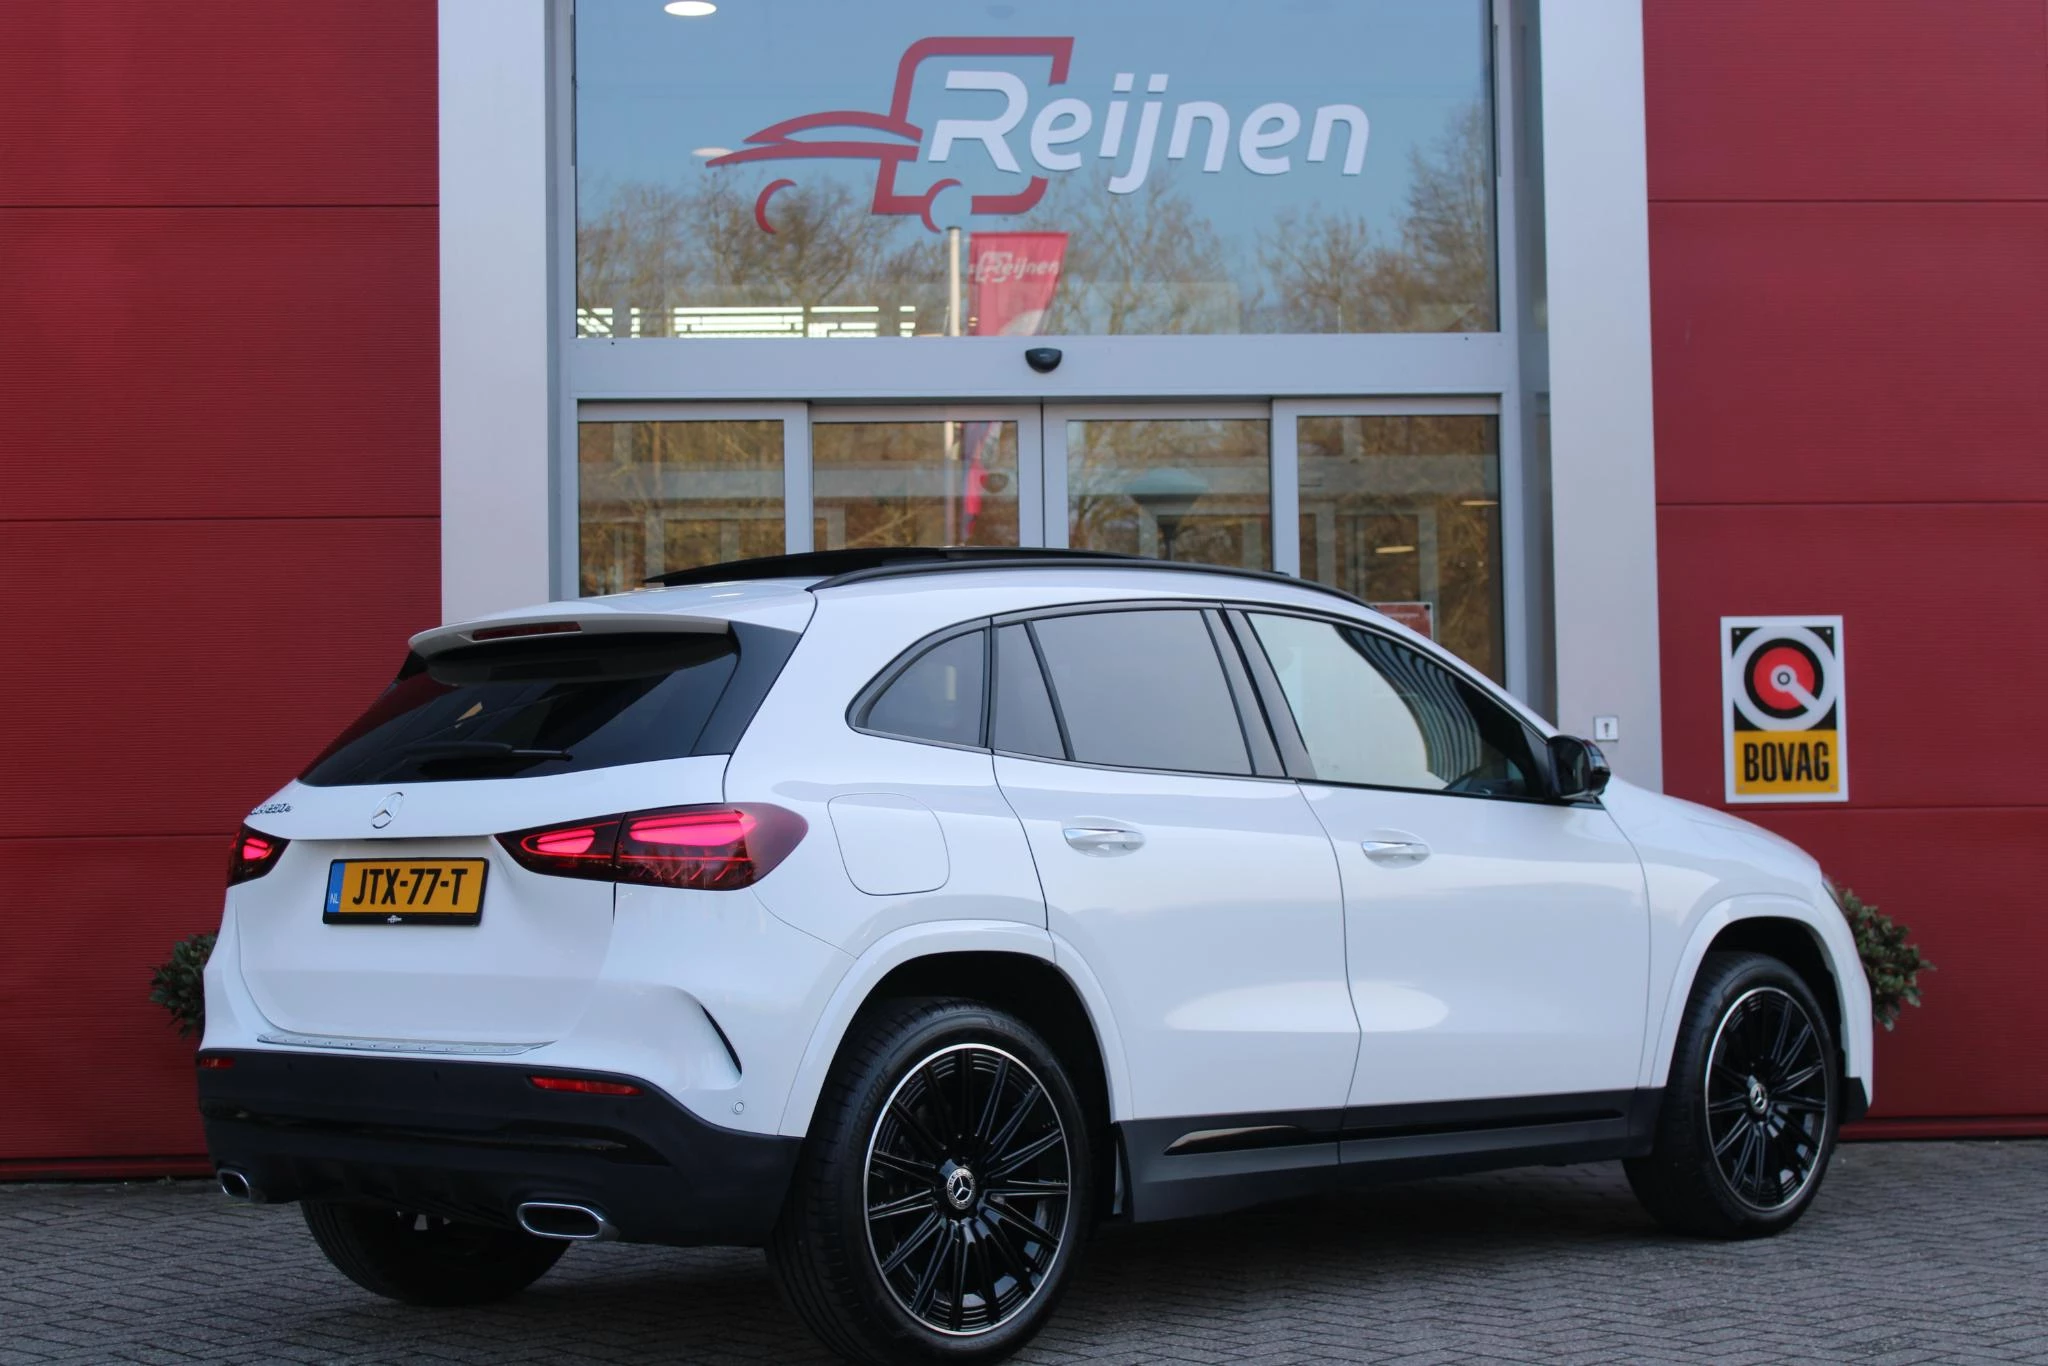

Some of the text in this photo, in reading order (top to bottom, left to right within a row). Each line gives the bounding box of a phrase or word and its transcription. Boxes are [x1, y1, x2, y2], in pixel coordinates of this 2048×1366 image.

[928, 70, 1370, 194] Reijnen
[984, 256, 1060, 280] Reijnen
[1743, 741, 1830, 782] BOVAG
[329, 868, 469, 906] NL JTX-77-T
